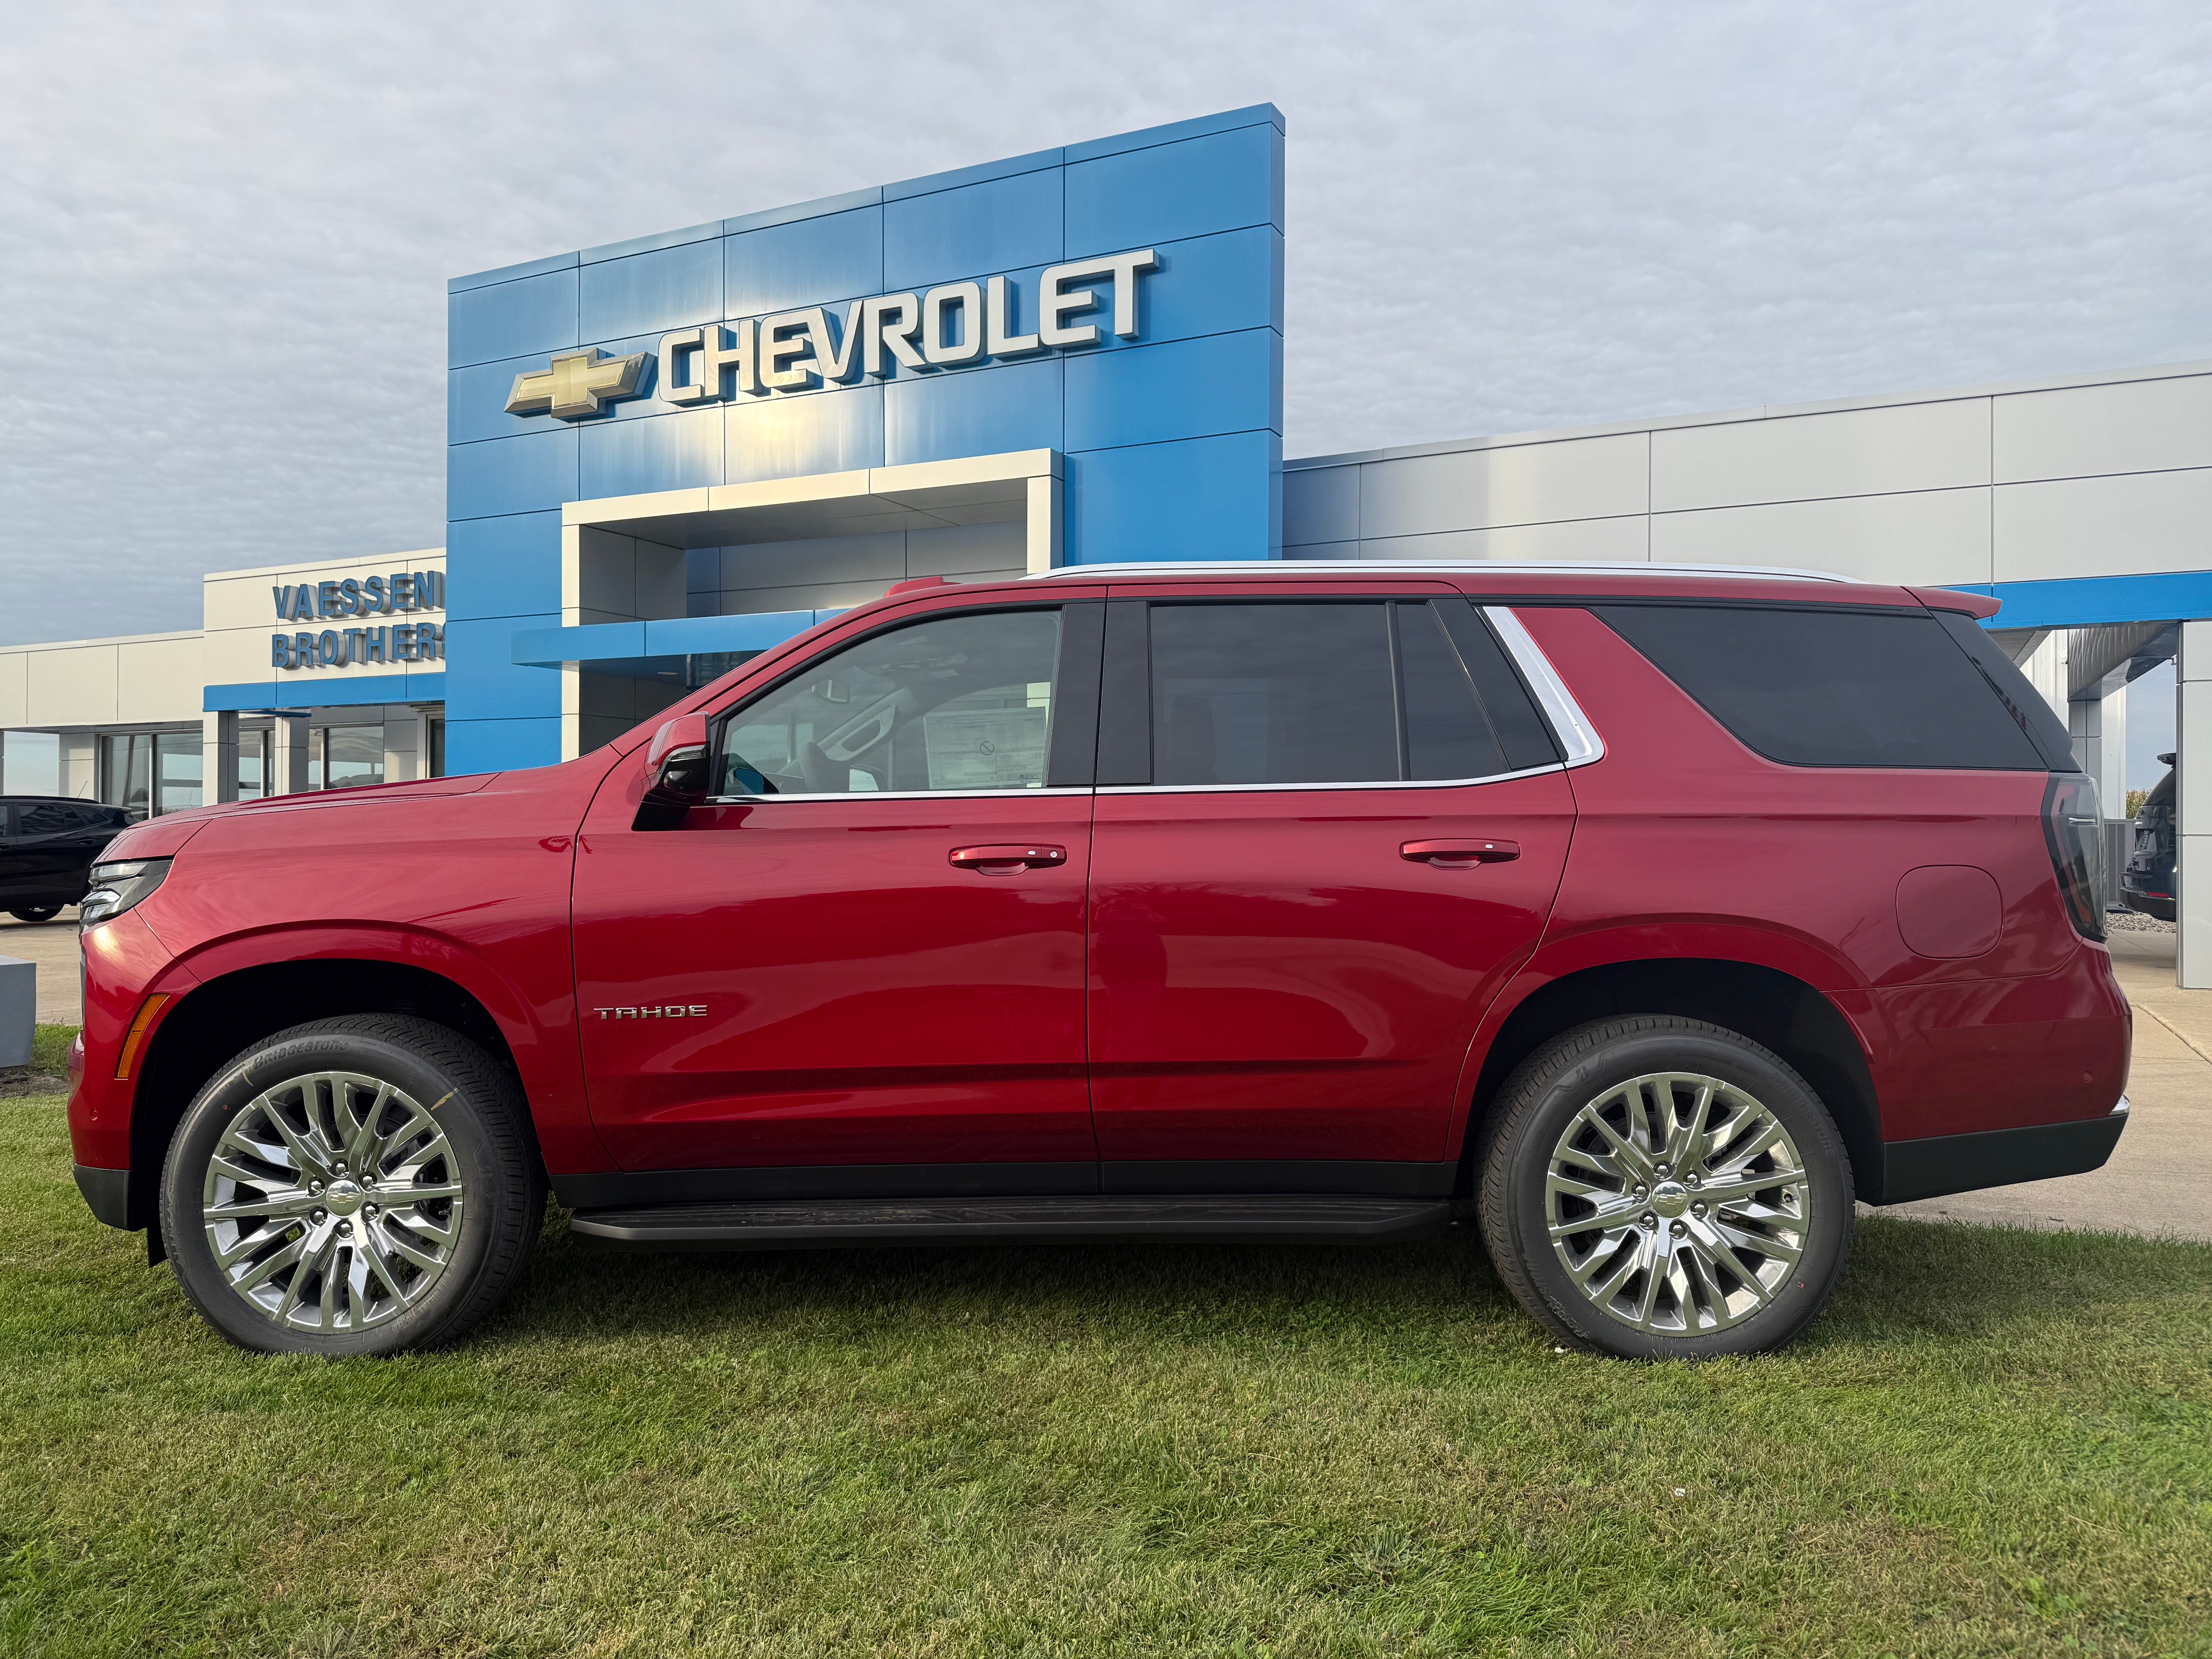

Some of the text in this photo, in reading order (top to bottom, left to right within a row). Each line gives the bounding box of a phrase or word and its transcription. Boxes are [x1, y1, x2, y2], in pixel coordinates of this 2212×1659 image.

[658, 249, 1159, 404] CHEVROLET
[273, 571, 438, 619] VAESSEN
[272, 623, 446, 667] BROTHER
[594, 1005, 708, 1019] TAHOE
[254, 1041, 349, 1070] BRIDGESTONE
